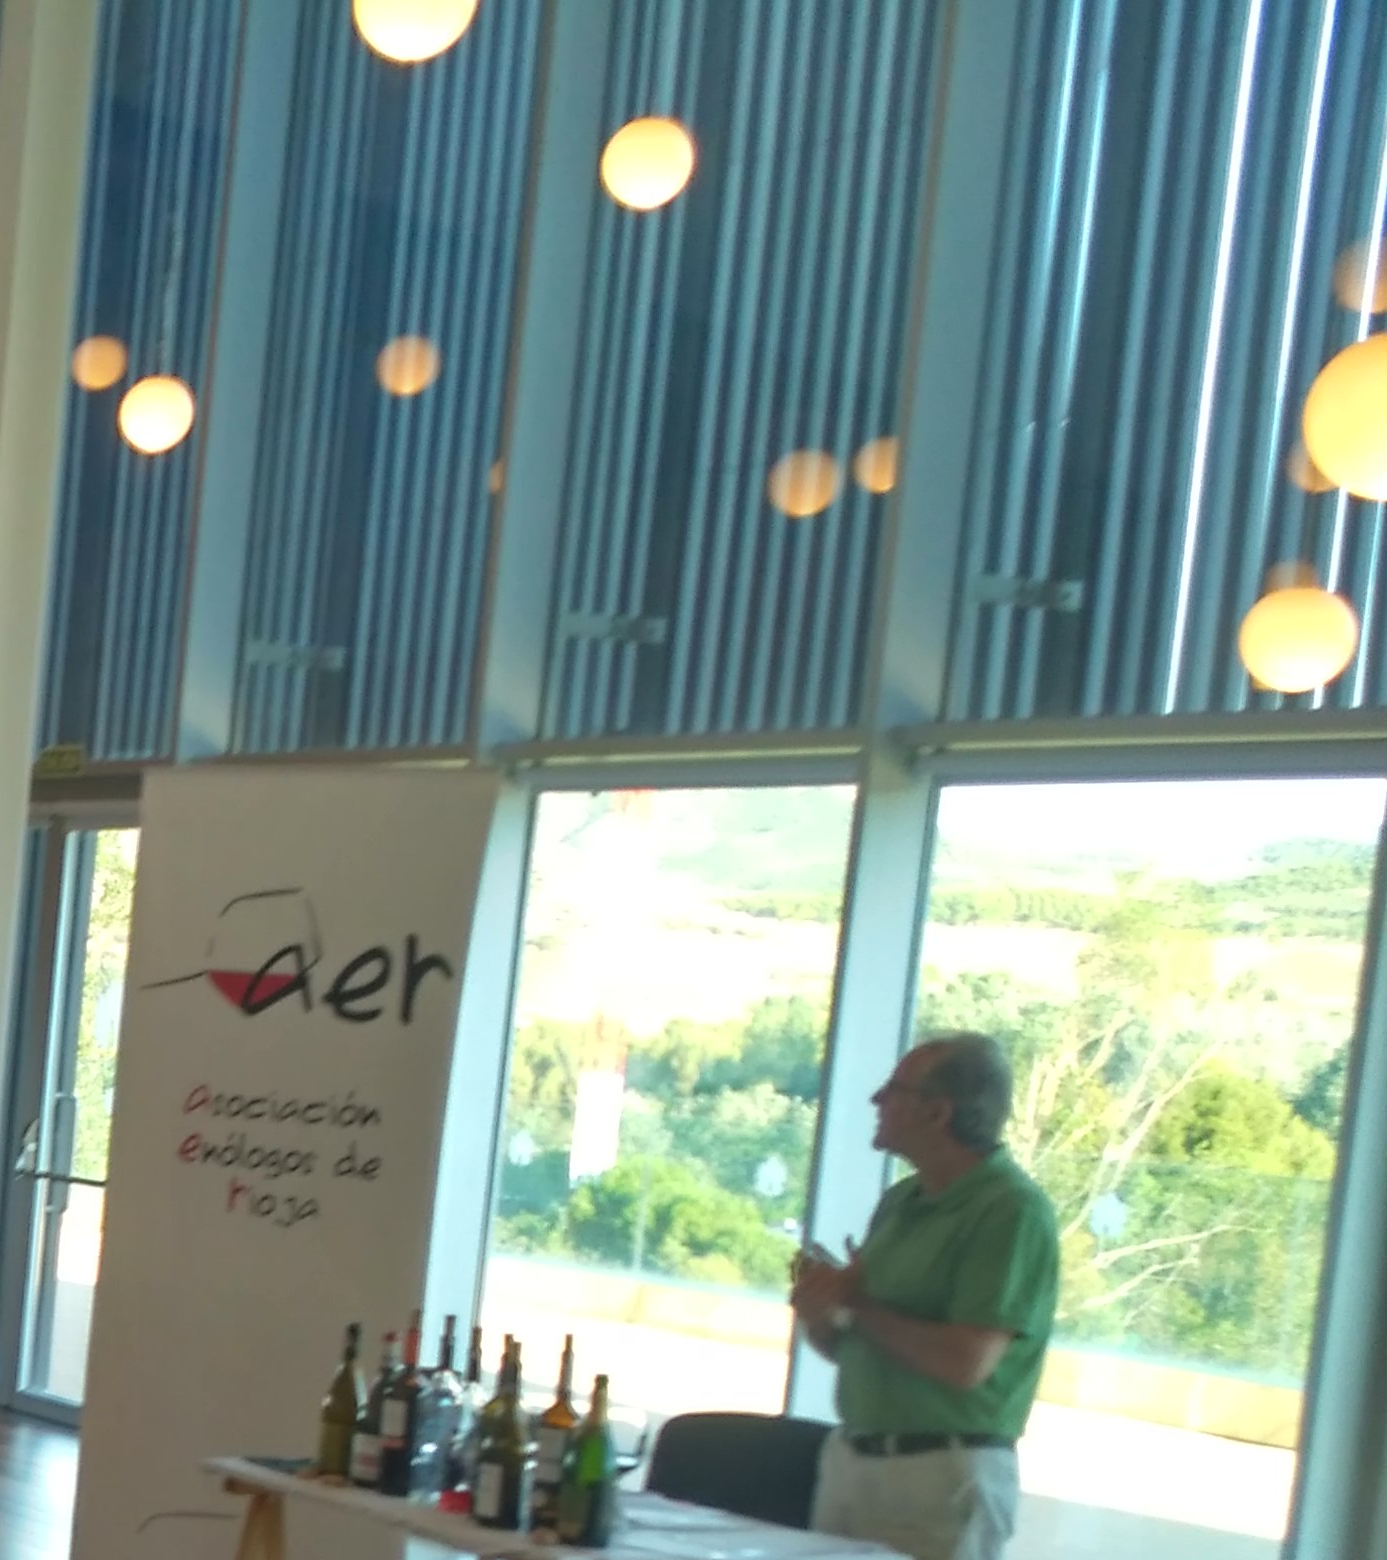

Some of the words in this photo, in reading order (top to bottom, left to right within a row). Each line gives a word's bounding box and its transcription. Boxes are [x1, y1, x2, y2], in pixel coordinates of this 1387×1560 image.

[239, 932, 454, 1027] aer
[183, 1083, 382, 1128] asociación
[179, 1131, 318, 1181] enólogos
[332, 1139, 382, 1181] de
[227, 1176, 321, 1228] rioja
